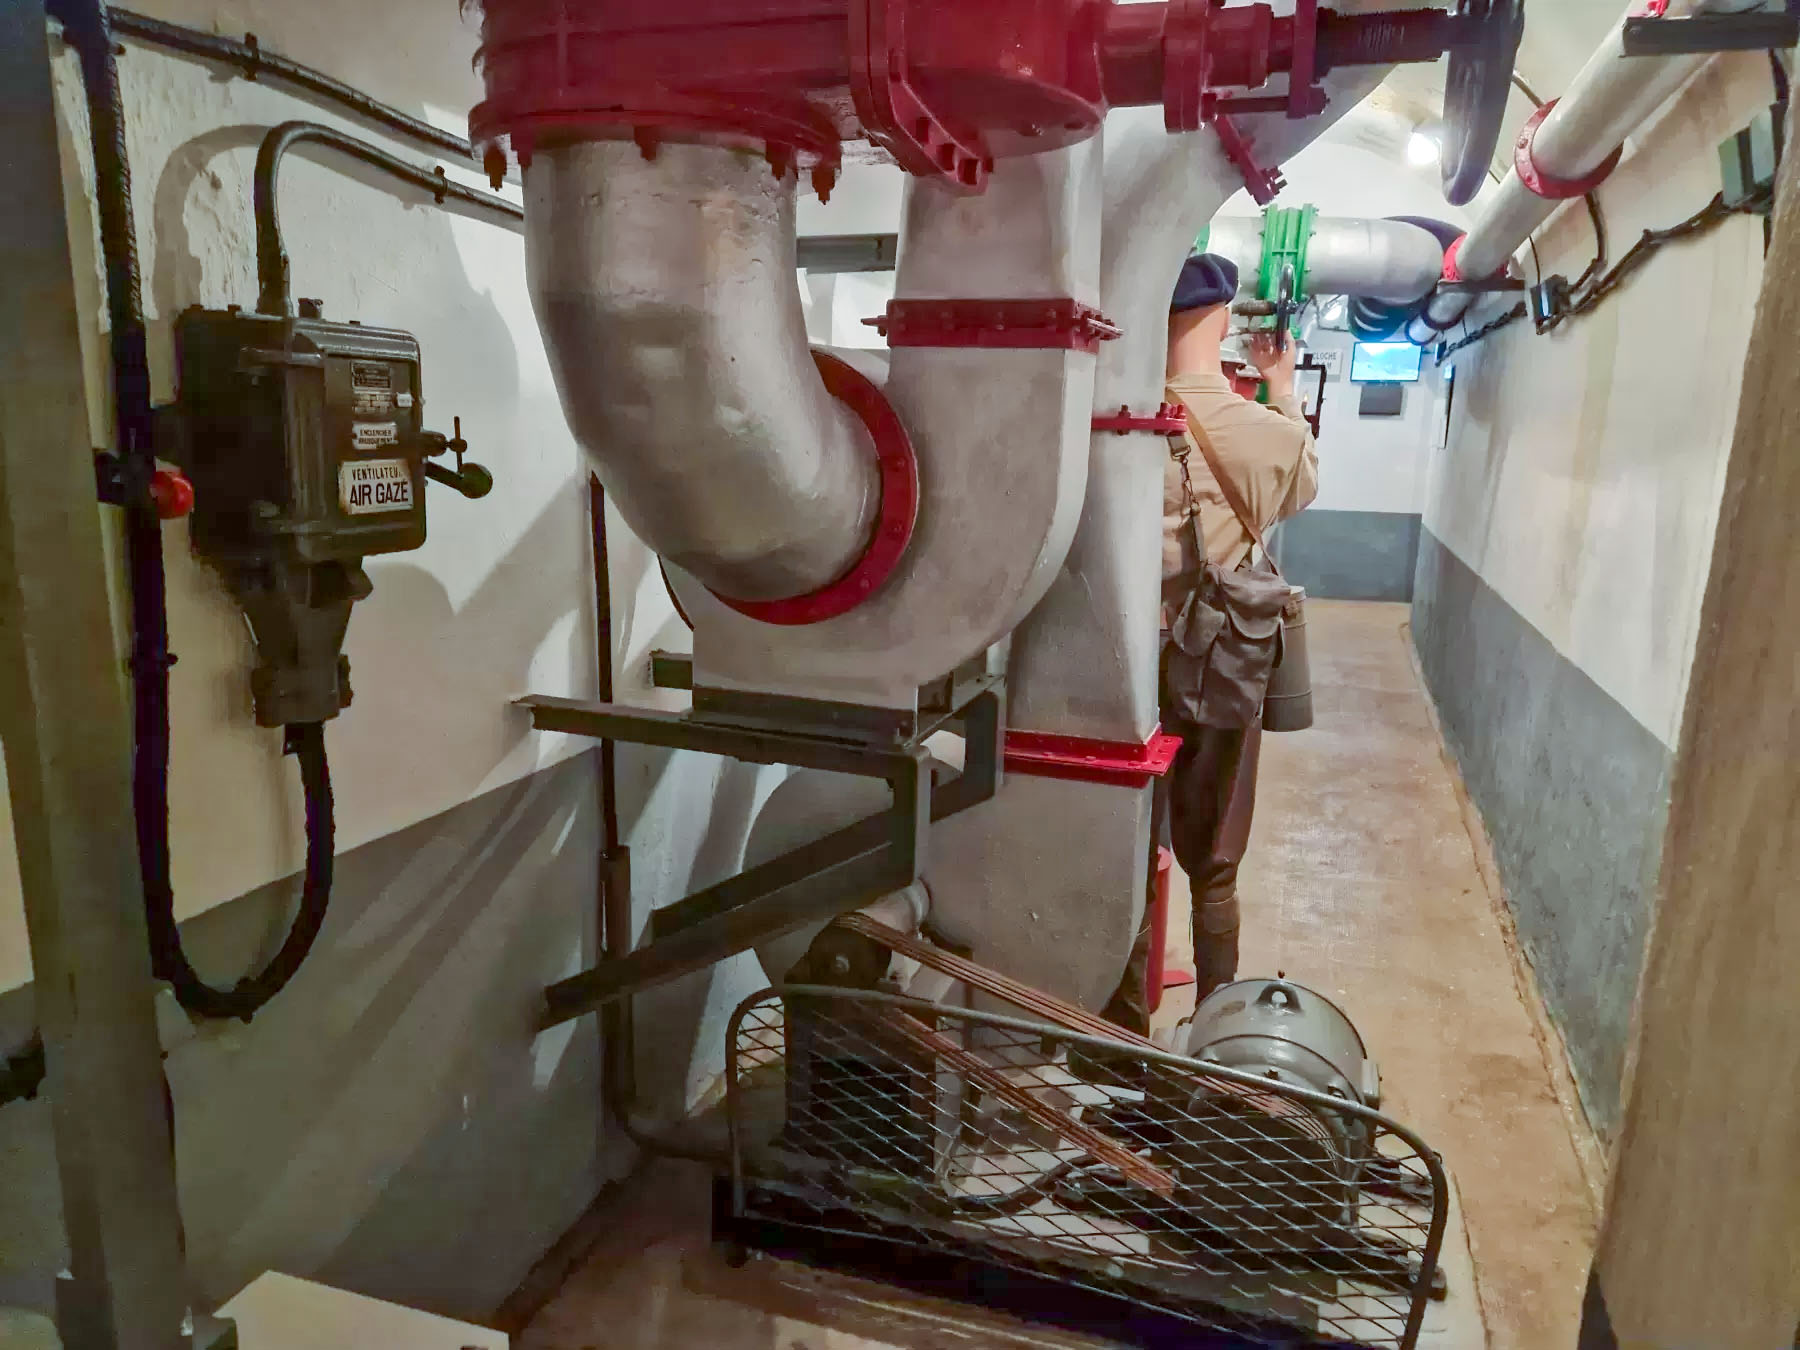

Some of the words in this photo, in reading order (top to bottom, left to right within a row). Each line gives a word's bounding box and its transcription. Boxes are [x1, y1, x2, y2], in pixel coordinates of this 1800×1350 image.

[1312, 351, 1337, 360] CLOCHE
[352, 466, 403, 481] VENTILATEU
[350, 483, 372, 506] AIR
